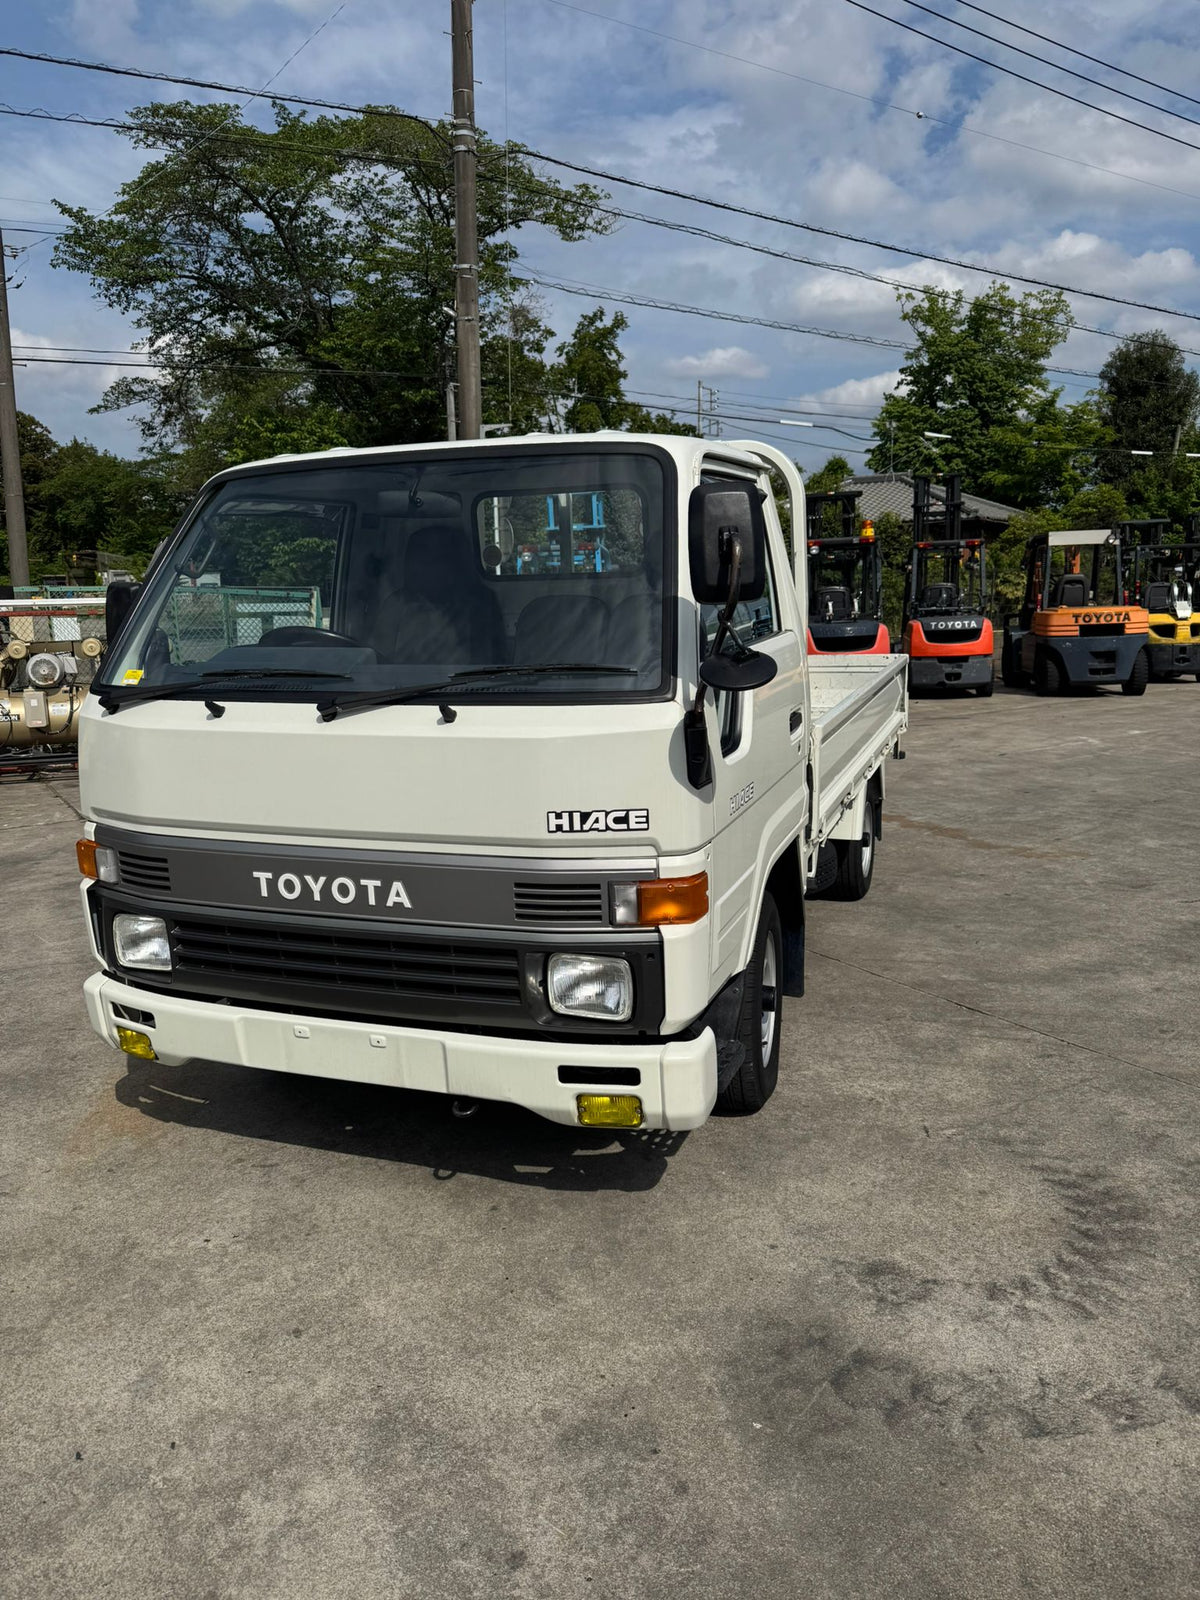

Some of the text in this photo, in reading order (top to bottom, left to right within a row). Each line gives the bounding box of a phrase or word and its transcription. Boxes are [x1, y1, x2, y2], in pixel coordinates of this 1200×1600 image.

[930, 620, 977, 629] TOYOTA
[1072, 612, 1131, 623] TOYOTA
[730, 781, 754, 816] HIACE
[547, 808, 649, 833] HIACE
[252, 871, 412, 909] TOYOTA
